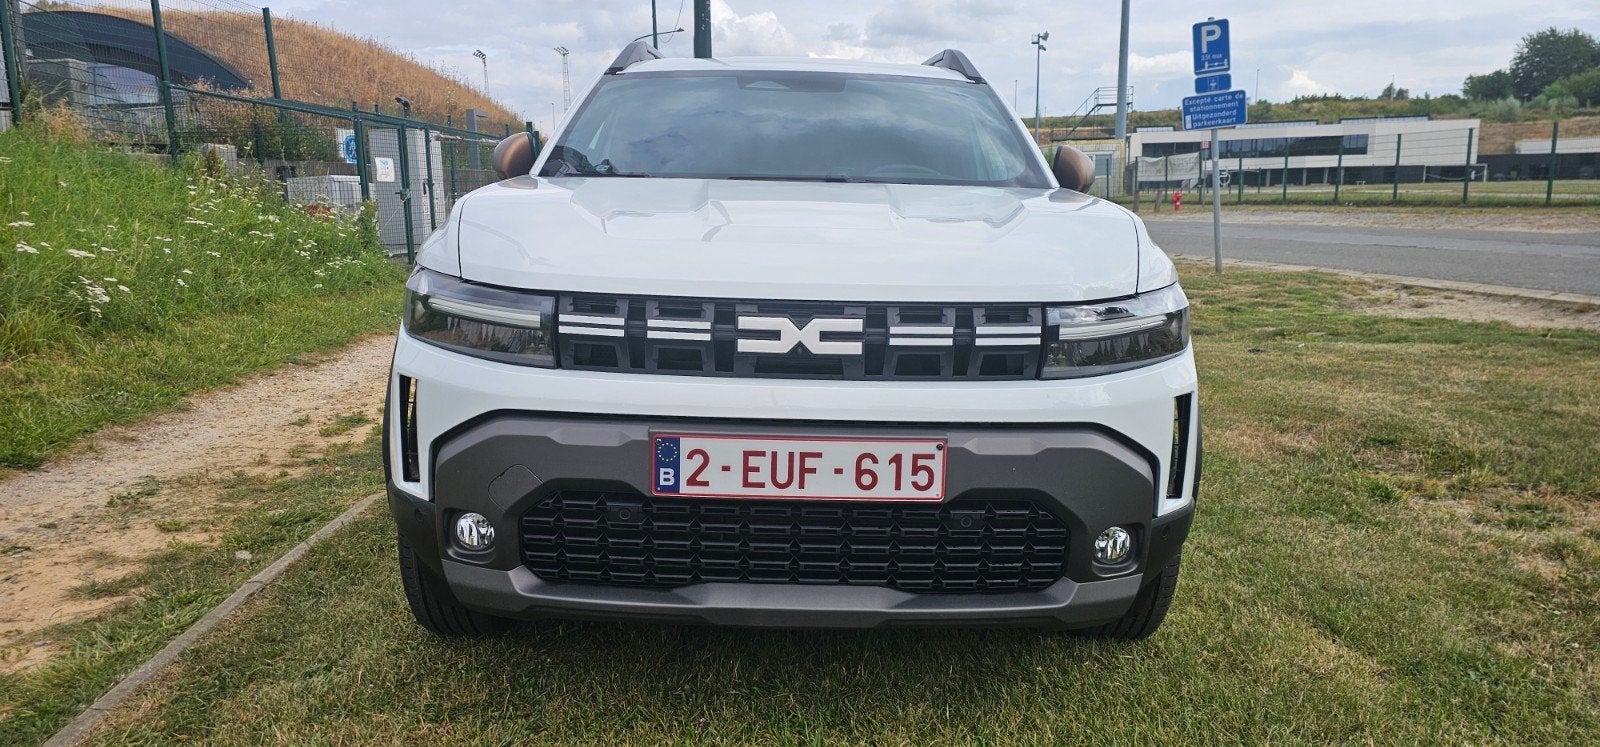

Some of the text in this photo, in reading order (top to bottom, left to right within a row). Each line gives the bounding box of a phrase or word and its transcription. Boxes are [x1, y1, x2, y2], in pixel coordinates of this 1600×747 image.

[1202, 24, 1221, 53] P
[1190, 101, 1238, 112] stationnement
[1192, 110, 1236, 120] Uitgezonderd
[1193, 118, 1236, 128] parkeerkaart
[660, 468, 674, 486] B
